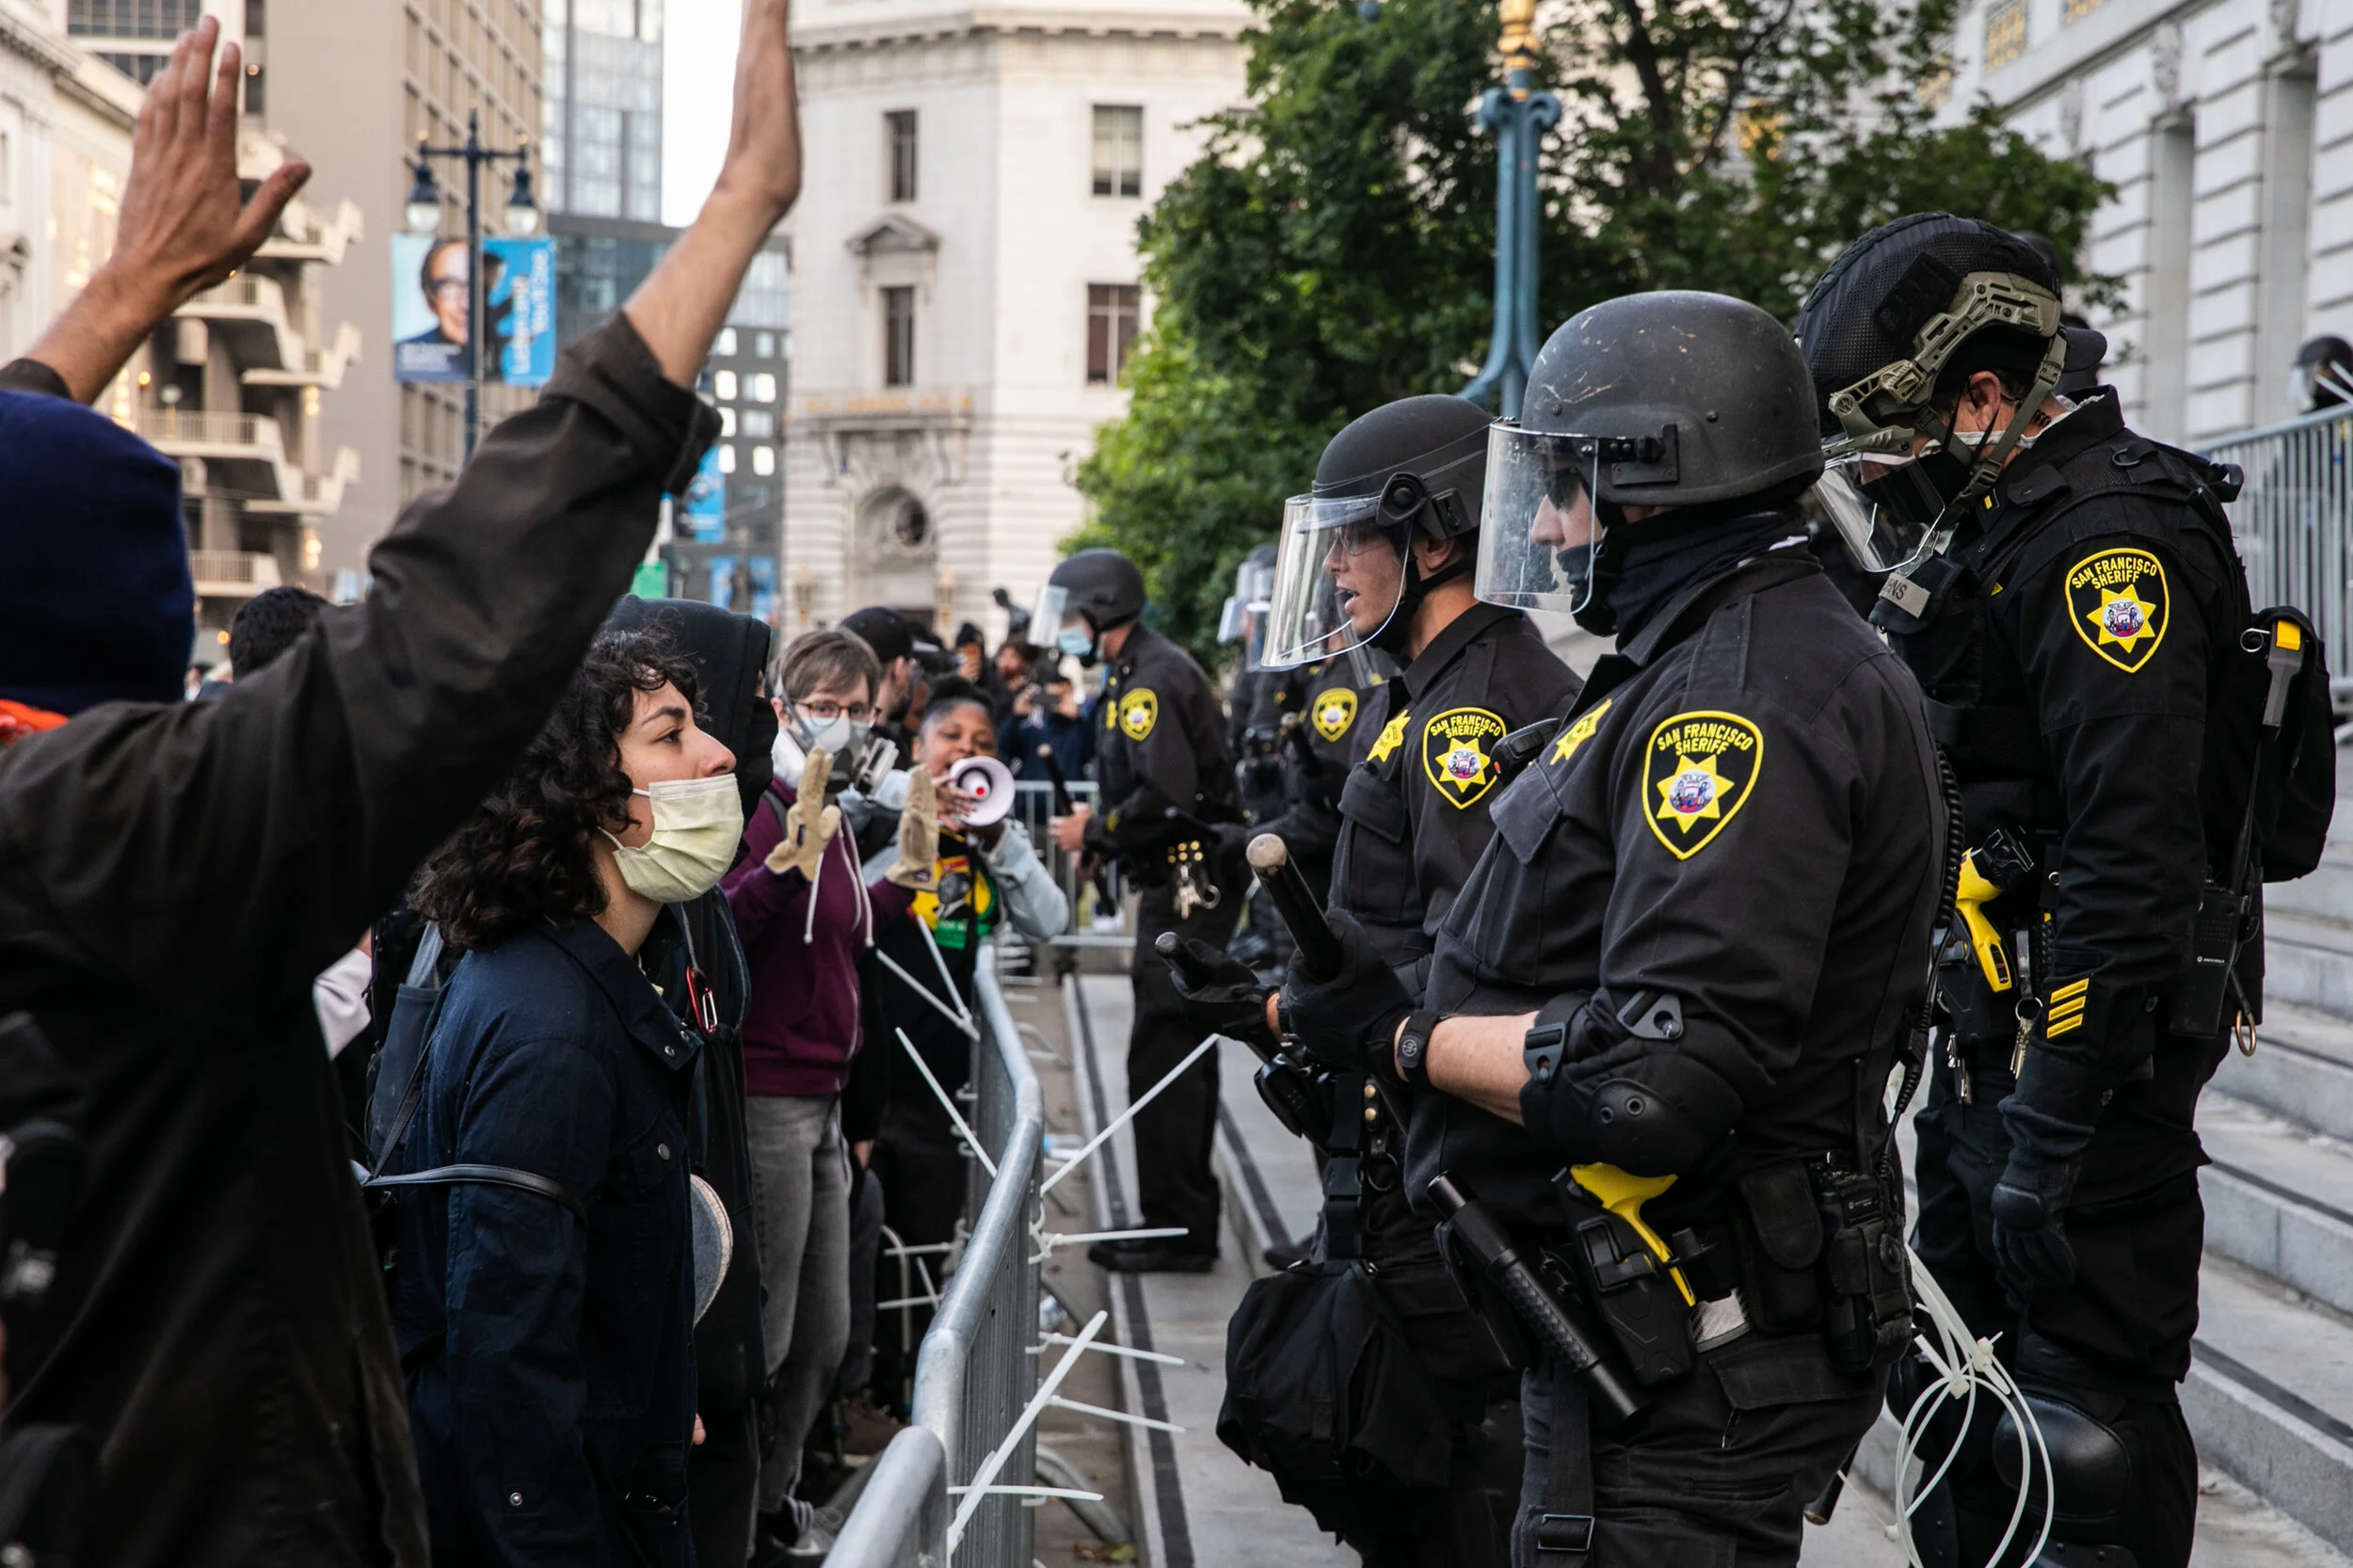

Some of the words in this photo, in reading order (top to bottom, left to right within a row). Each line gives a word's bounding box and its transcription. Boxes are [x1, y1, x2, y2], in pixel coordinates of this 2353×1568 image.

[2072, 568, 2095, 589] SAN
[2094, 556, 2157, 577] FRANCISCO
[2091, 569, 2140, 589] SHERIFF
[1430, 722, 1449, 737] SAN
[1450, 714, 1501, 737] FRANCISCO
[1445, 724, 1486, 738] SHERIFF
[1657, 728, 1681, 751] SAN
[1683, 722, 1753, 751] FRANCISCO
[1675, 737, 1730, 756] SHERIFF
